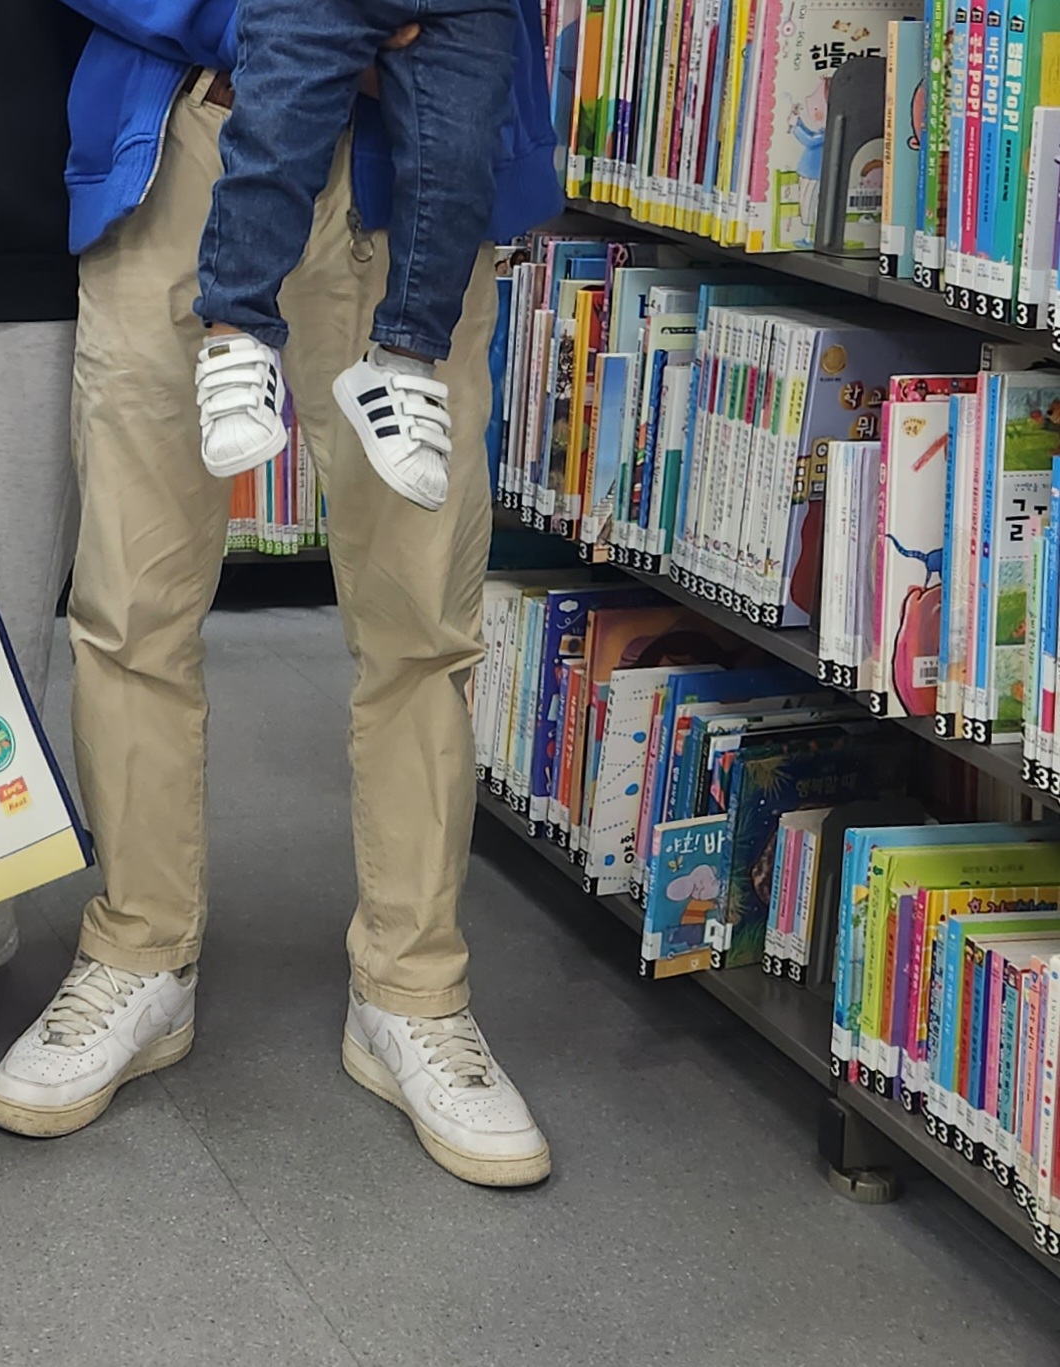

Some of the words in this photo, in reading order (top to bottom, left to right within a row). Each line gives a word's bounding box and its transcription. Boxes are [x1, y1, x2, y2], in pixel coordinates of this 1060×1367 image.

[985, 37, 1000, 71] 바다
[879, 256, 889, 275] 3
[913, 264, 923, 282] 3
[922, 269, 931, 288] 3
[945, 286, 955, 305] 3
[959, 289, 970, 309] 3
[976, 294, 987, 315] 3
[992, 299, 1004, 319] 3
[1016, 304, 1028, 324] 3
[503, 492, 511, 508] 3
[560, 520, 567, 536] 3
[579, 542, 587, 559] 3
[608, 544, 616, 561] 3
[633, 550, 641, 567] 3
[643, 554, 652, 570] 3
[670, 564, 679, 583] 3
[681, 571, 689, 588] 3
[689, 576, 697, 593] 3
[705, 582, 716, 600] 3
[723, 590, 732, 607] 3
[732, 595, 741, 612] 3
[749, 606, 760, 623] 3
[767, 606, 778, 623] 3
[818, 661, 826, 679] 3
[833, 666, 842, 683] 3
[842, 667, 851, 685] 3
[869, 694, 880, 713] 3
[934, 716, 946, 735] 3
[963, 719, 973, 739] 3
[974, 723, 986, 742] 3
[494, 778, 503, 796] 3
[1034, 768, 1049, 789] 3
[510, 794, 519, 811] 3
[519, 795, 526, 812] 3
[528, 821, 536, 837] 3
[547, 823, 554, 839] 3
[557, 831, 566, 847] 3
[666, 833, 700, 855] 야호!
[578, 852, 585, 866] 3
[583, 877, 591, 893] 3
[631, 883, 640, 899] 3
[640, 960, 647, 976] 3
[711, 951, 720, 968] 3
[763, 955, 772, 973] 3
[772, 958, 782, 975] 3
[831, 1057, 840, 1076] 3
[859, 1067, 869, 1086] 3
[875, 1074, 886, 1093] 3
[902, 1091, 913, 1111] 3
[925, 1115, 937, 1136] 3
[937, 1122, 948, 1143] 3
[954, 1132, 964, 1151] 3
[964, 1140, 974, 1160] 3
[983, 1149, 995, 1170] 3
[996, 1165, 1009, 1186] 3
[1014, 1185, 1029, 1207] 3
[1034, 1223, 1046, 1245] 3
[1048, 1234, 1059, 1255] 3
